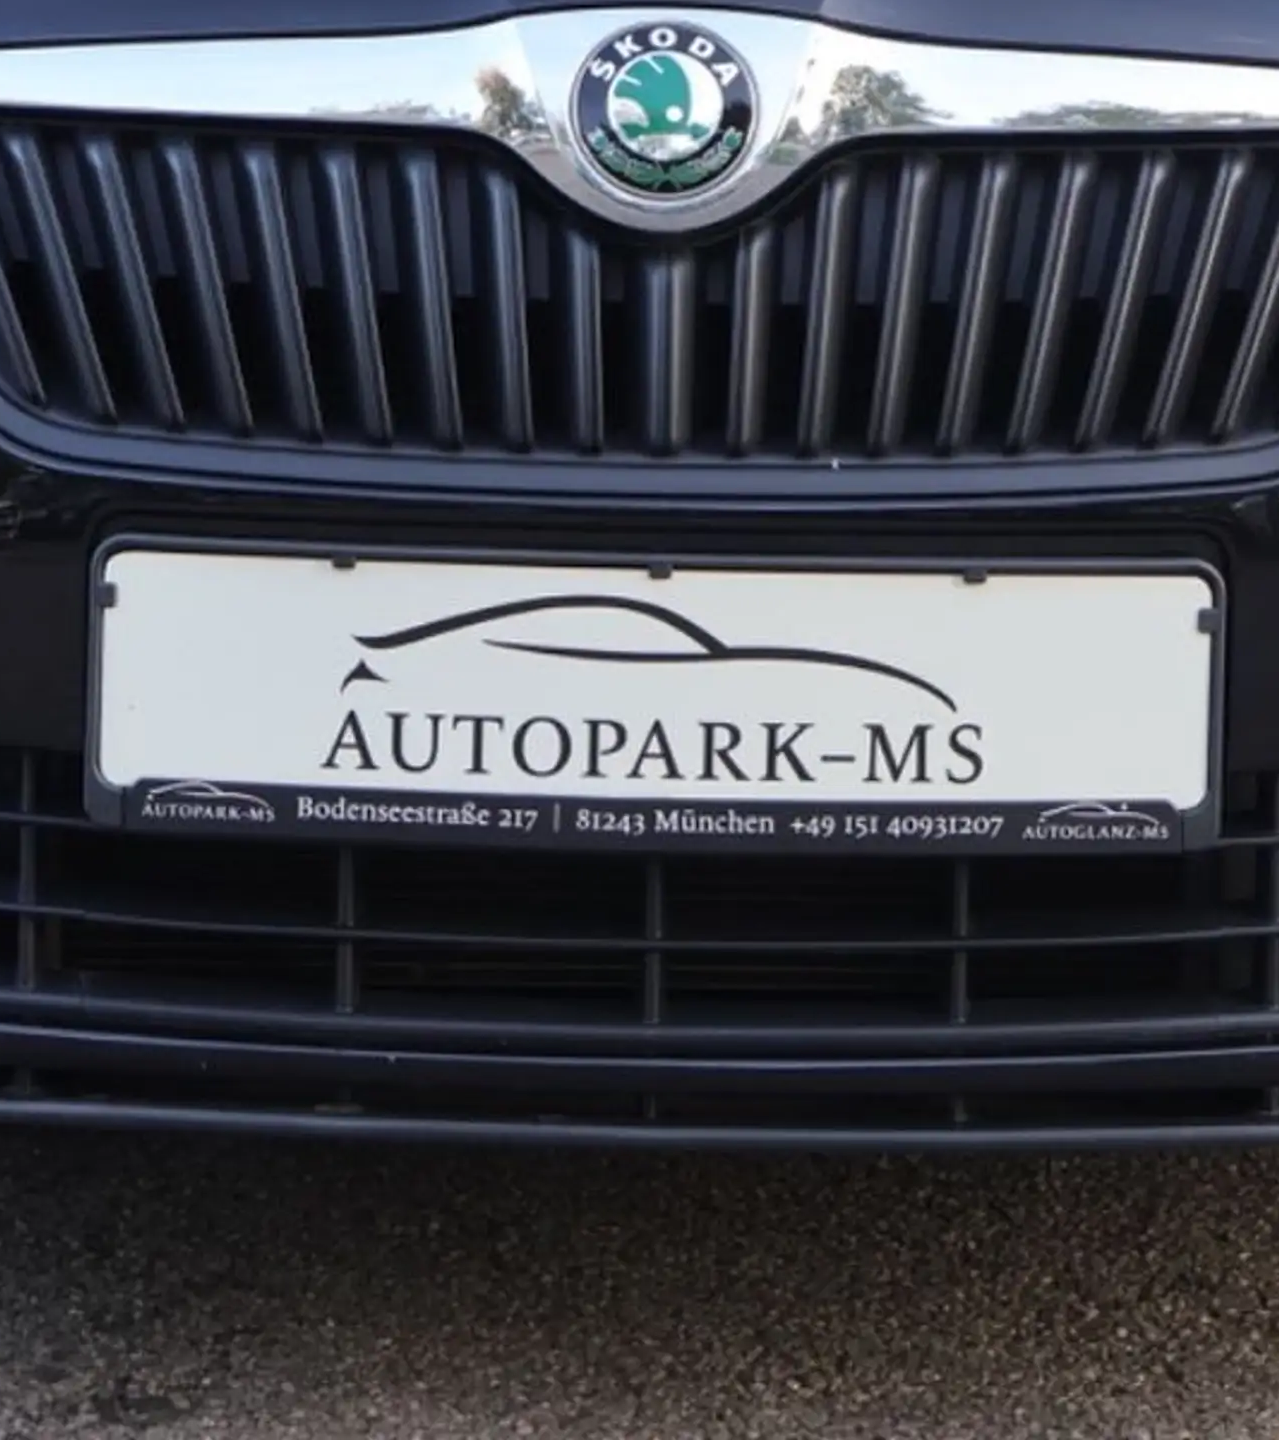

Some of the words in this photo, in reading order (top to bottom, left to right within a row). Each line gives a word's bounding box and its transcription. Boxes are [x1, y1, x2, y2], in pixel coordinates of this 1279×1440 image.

[321, 709, 985, 786] AUTOPARK-MS
[142, 802, 275, 823] AUTOPARK-MS
[296, 796, 491, 827] Bodenseestraße
[498, 808, 538, 834] 217
[576, 808, 647, 836] 81243
[654, 809, 775, 835] München
[790, 815, 836, 839] +49
[844, 815, 880, 839] 151
[886, 815, 1004, 839] 40931207
